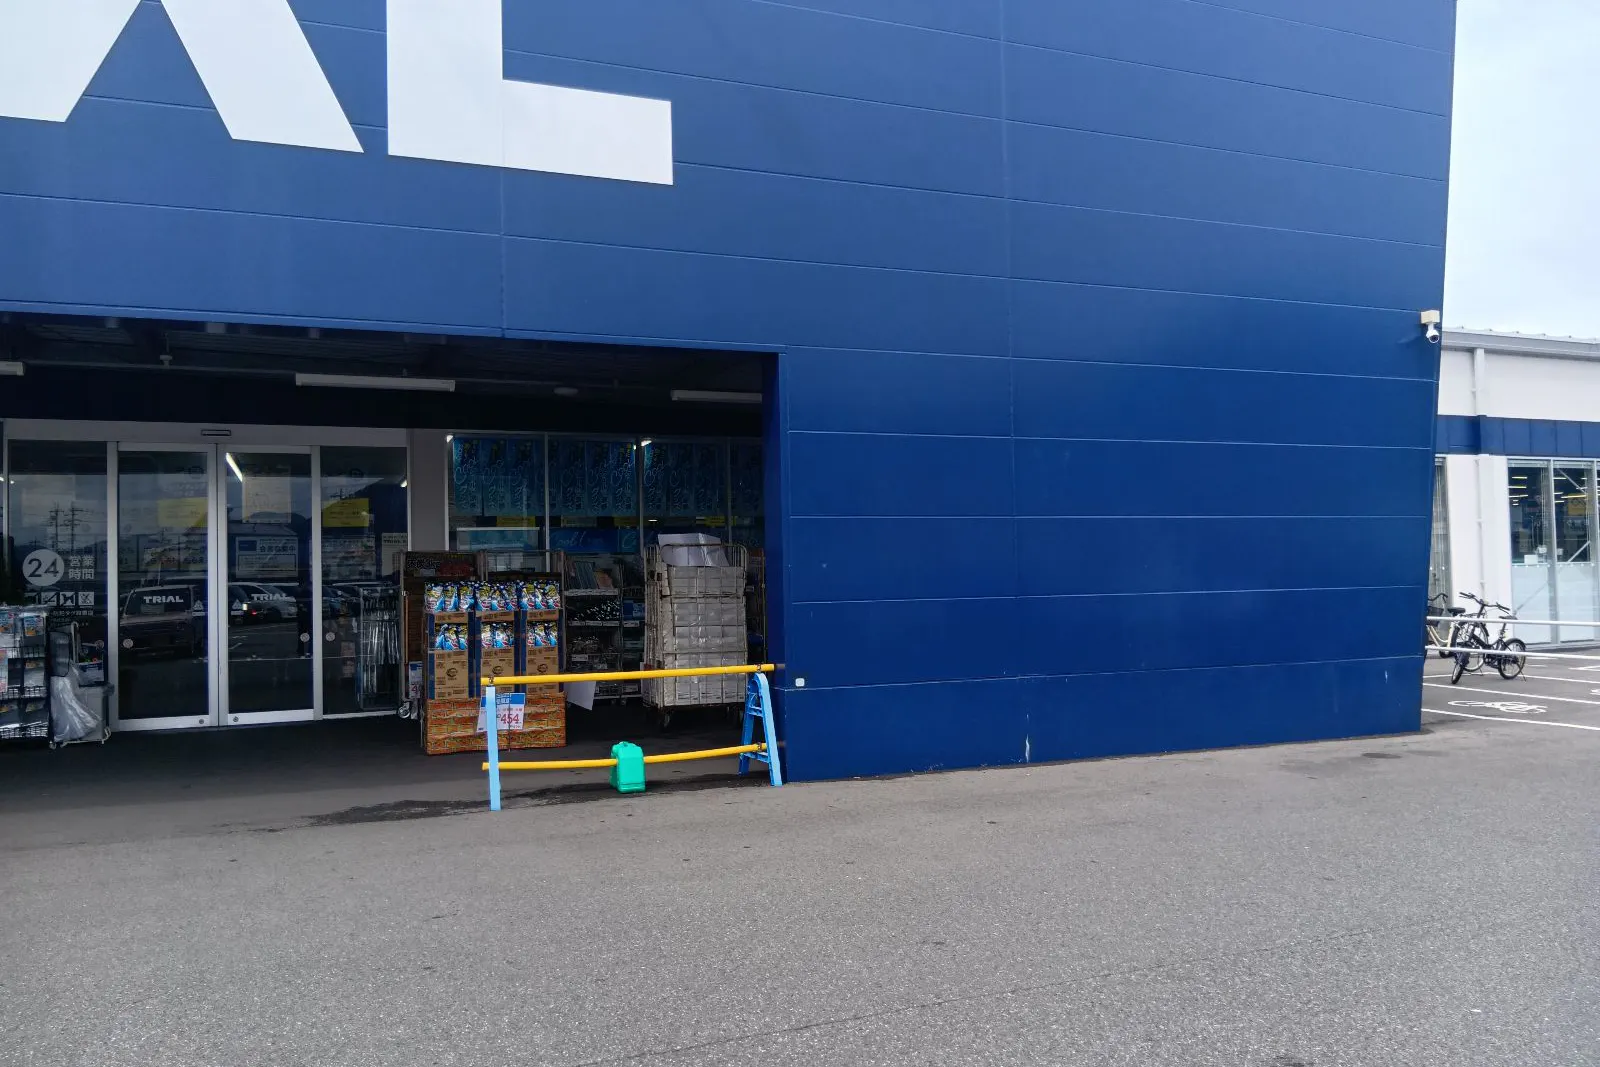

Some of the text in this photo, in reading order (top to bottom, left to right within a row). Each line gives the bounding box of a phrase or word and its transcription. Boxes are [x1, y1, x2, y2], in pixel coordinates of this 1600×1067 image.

[68, 555, 95, 567] 営業
[28, 558, 59, 578] 24
[68, 568, 95, 580] 時間
[143, 595, 184, 604] TRIAL
[251, 593, 292, 602] TRIAL
[500, 713, 520, 724] 454
